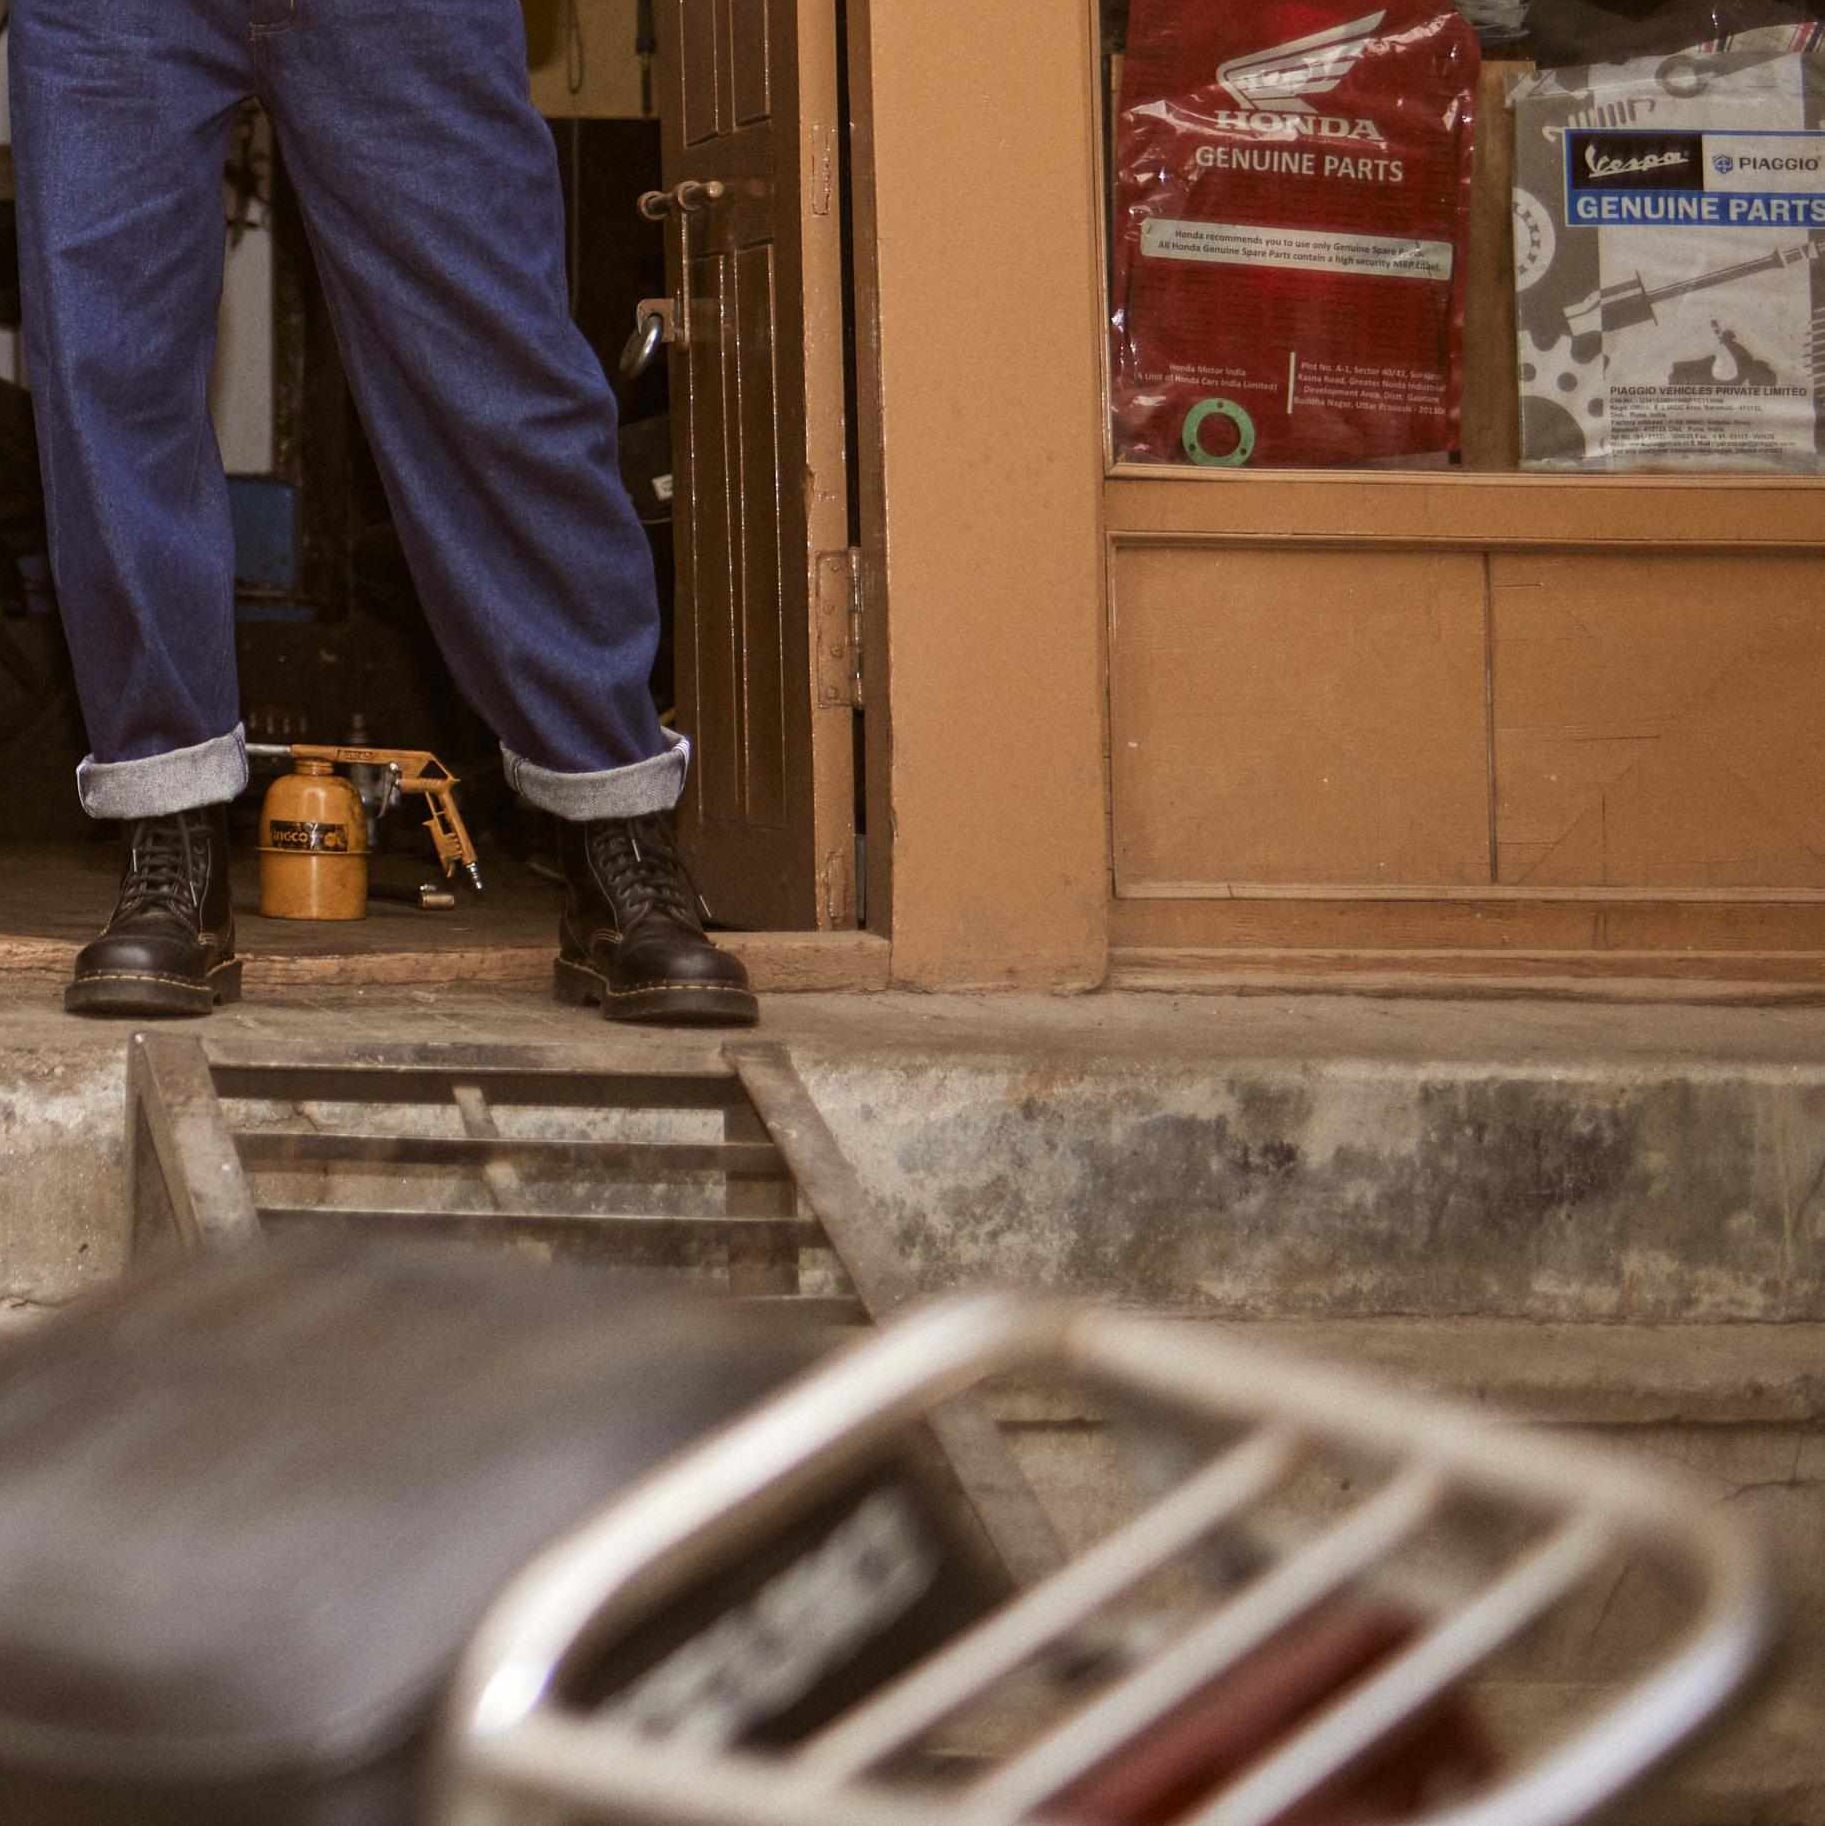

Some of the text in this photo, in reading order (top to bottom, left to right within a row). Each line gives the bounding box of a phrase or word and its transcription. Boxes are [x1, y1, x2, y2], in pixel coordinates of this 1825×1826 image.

[1213, 109, 1385, 141] HONDA
[1195, 145, 1404, 183] GENUINE PARTS
[1584, 141, 1819, 179] Vespa PIAGGIO
[1576, 195, 1825, 223] GENUINE PARTS
[1172, 242, 1200, 252] Honda
[1202, 244, 1240, 255] Genuine
[1242, 247, 1267, 258] Spare
[1269, 250, 1291, 260] Parts
[1293, 253, 1326, 263] contain
[1335, 255, 1354, 266] high
[1355, 257, 1391, 269] security
[1175, 230, 1204, 240] Honda
[1206, 234, 1263, 245] recommends
[1265, 239, 1282, 248] you
[1312, 242, 1332, 252] only
[1333, 243, 1371, 253] Genuine
[1609, 386, 1807, 397] PIAGGIO VEHICLES PRIVATE LIMITED
